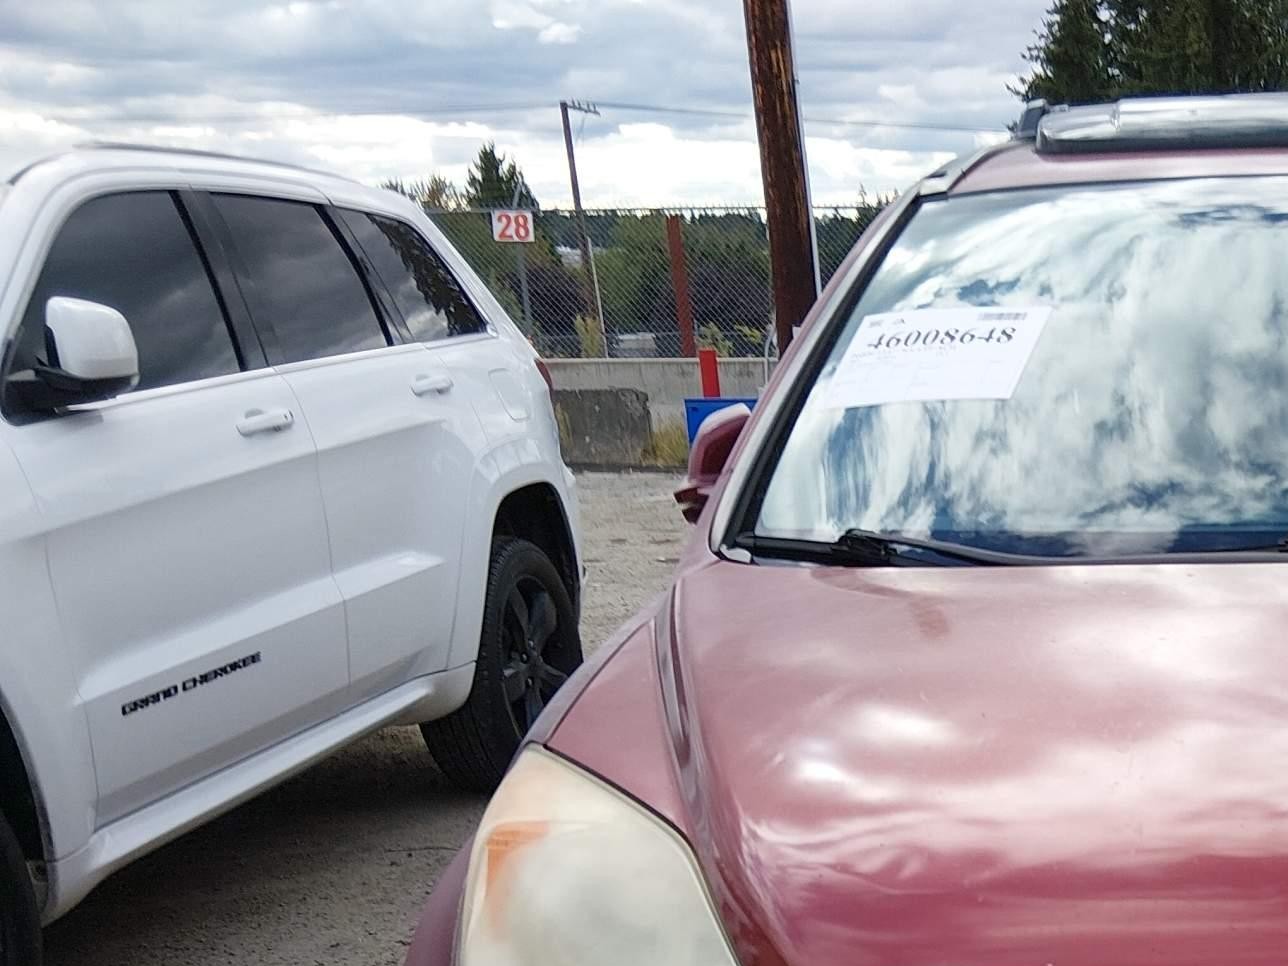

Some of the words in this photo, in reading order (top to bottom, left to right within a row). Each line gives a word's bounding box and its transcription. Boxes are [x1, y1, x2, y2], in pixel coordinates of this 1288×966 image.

[497, 214, 529, 240] 28
[866, 326, 1016, 349] 46008648
[121, 685, 178, 716] GRAND
[182, 651, 261, 691] CHEROKEE
